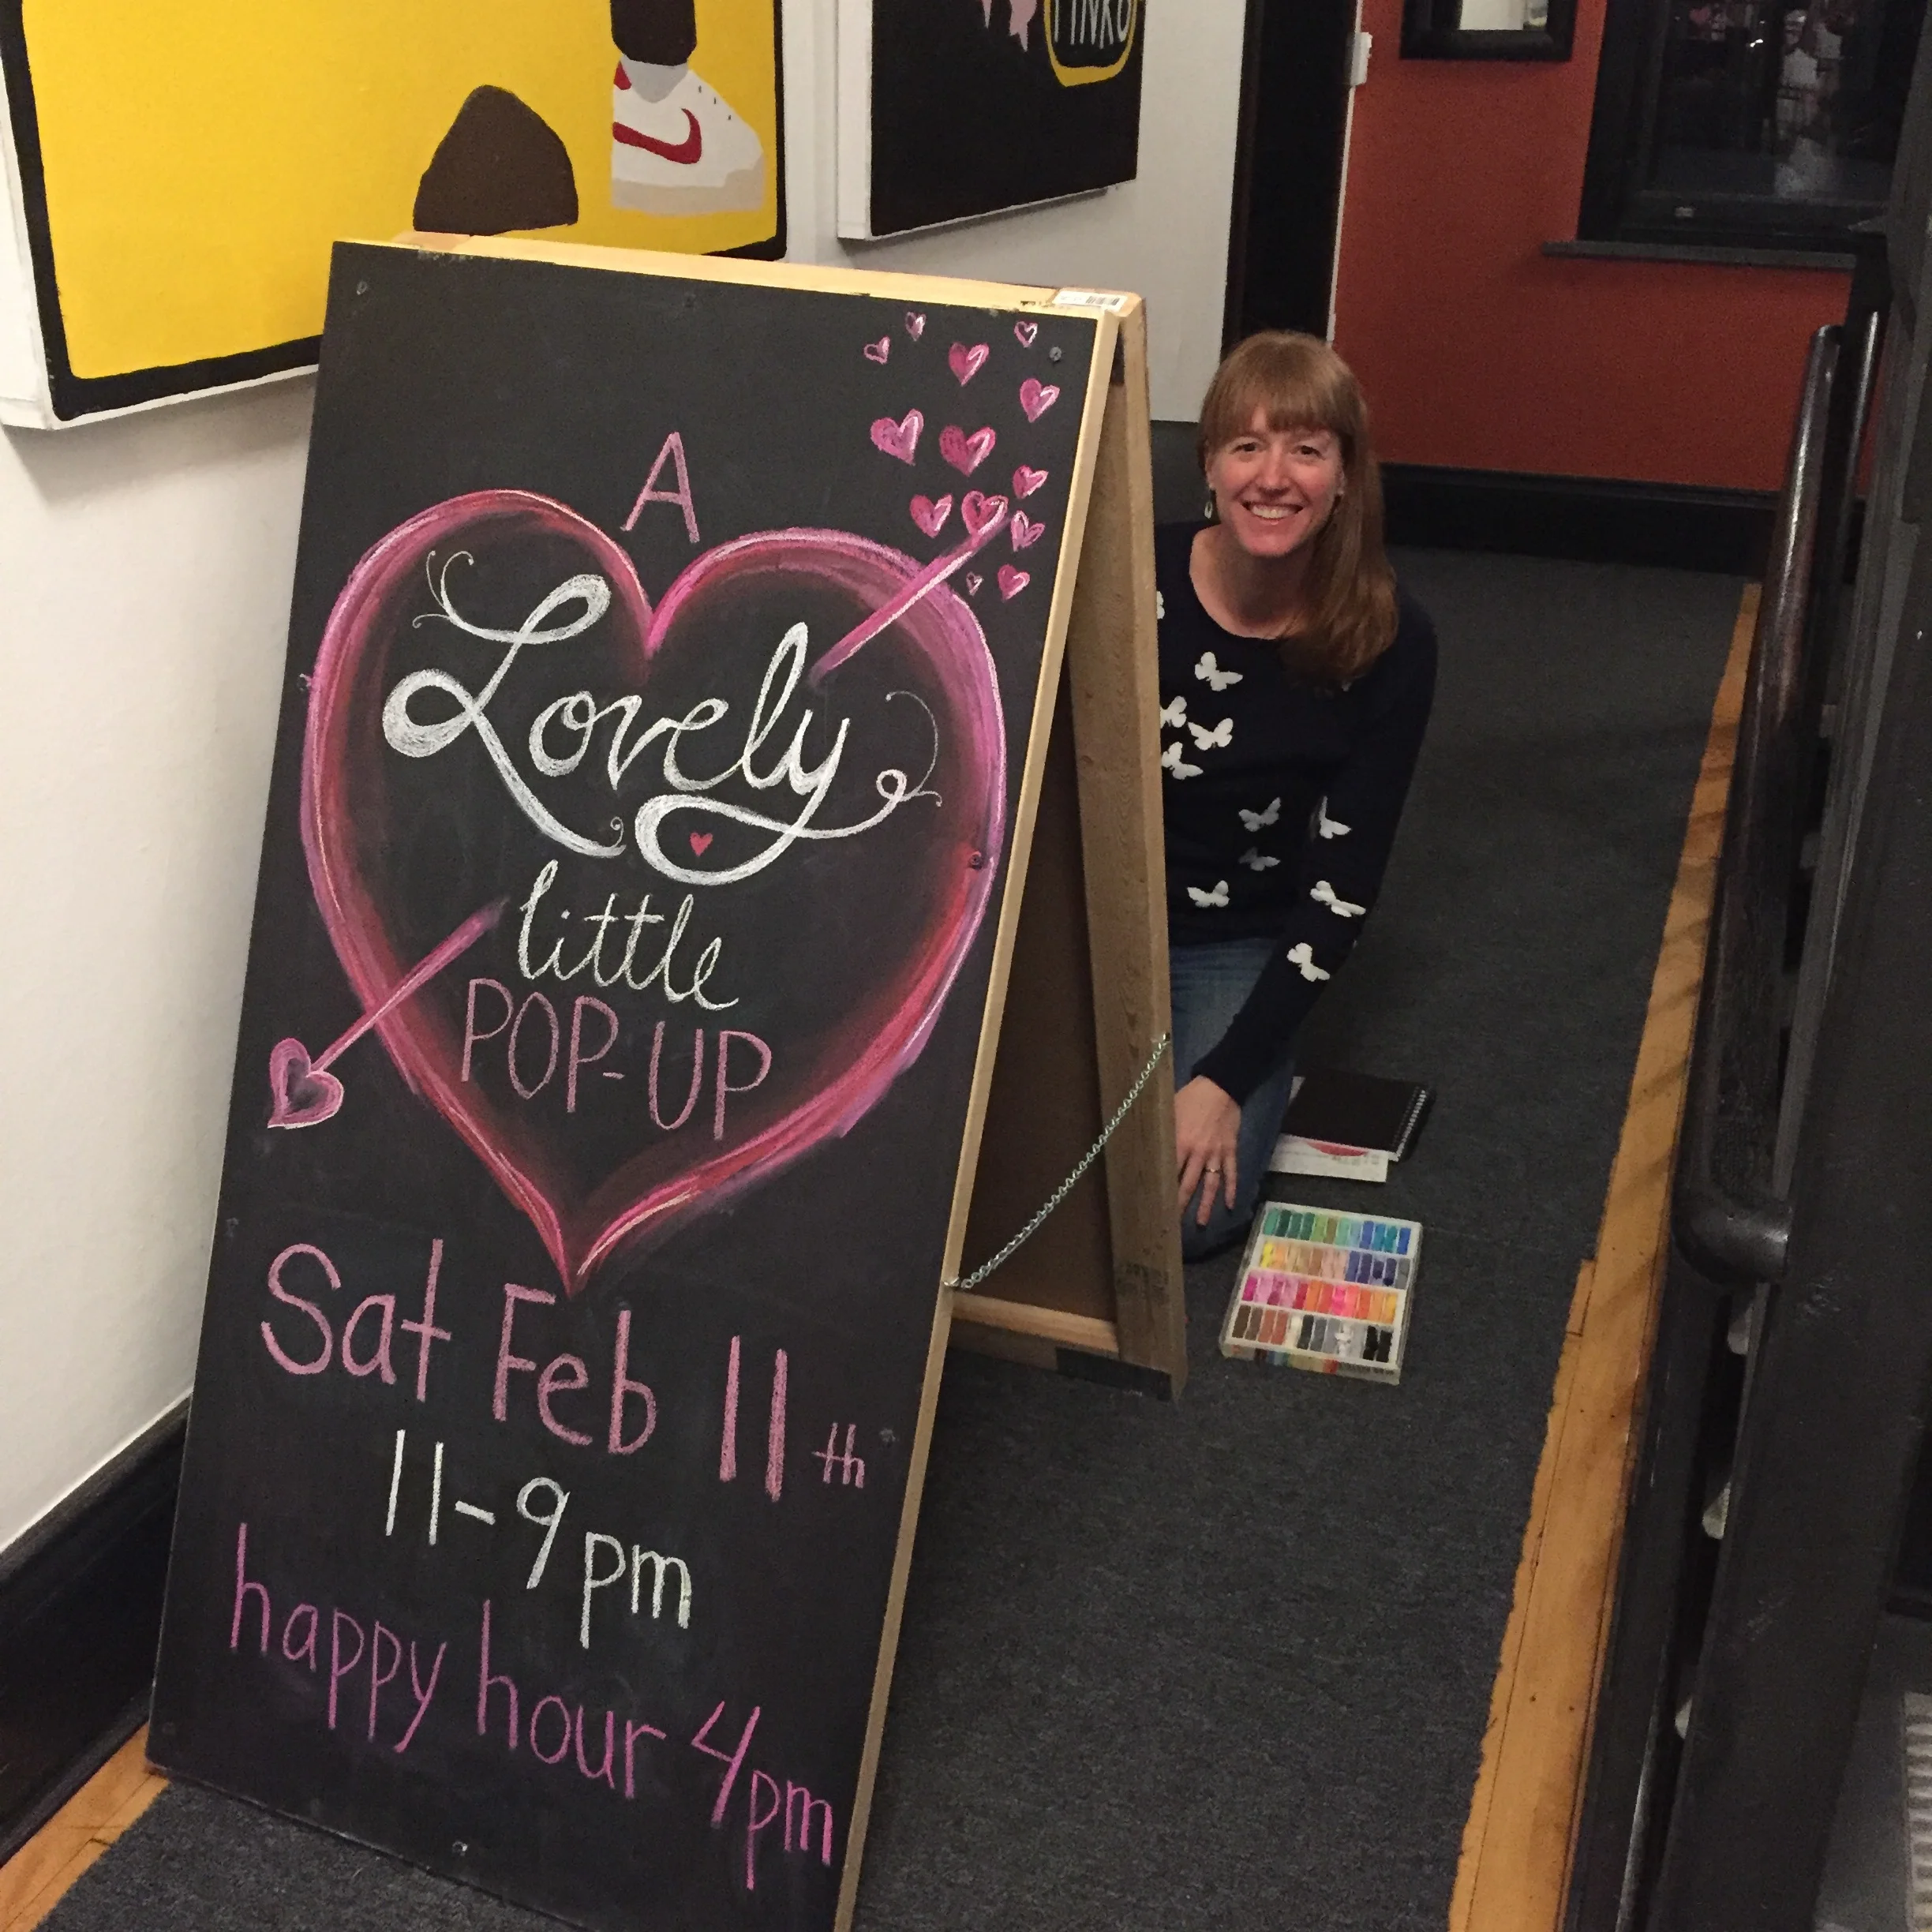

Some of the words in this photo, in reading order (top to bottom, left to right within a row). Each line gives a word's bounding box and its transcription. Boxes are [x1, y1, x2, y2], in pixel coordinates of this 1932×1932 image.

[620, 431, 701, 545] A
[383, 549, 942, 886] Lovely
[518, 859, 739, 1010] little
[461, 978, 773, 1141] POP-UP
[260, 1238, 452, 1402] Sat
[492, 1282, 658, 1455] Feb
[230, 1522, 447, 1754] happy
[477, 1599, 667, 1799] hour
